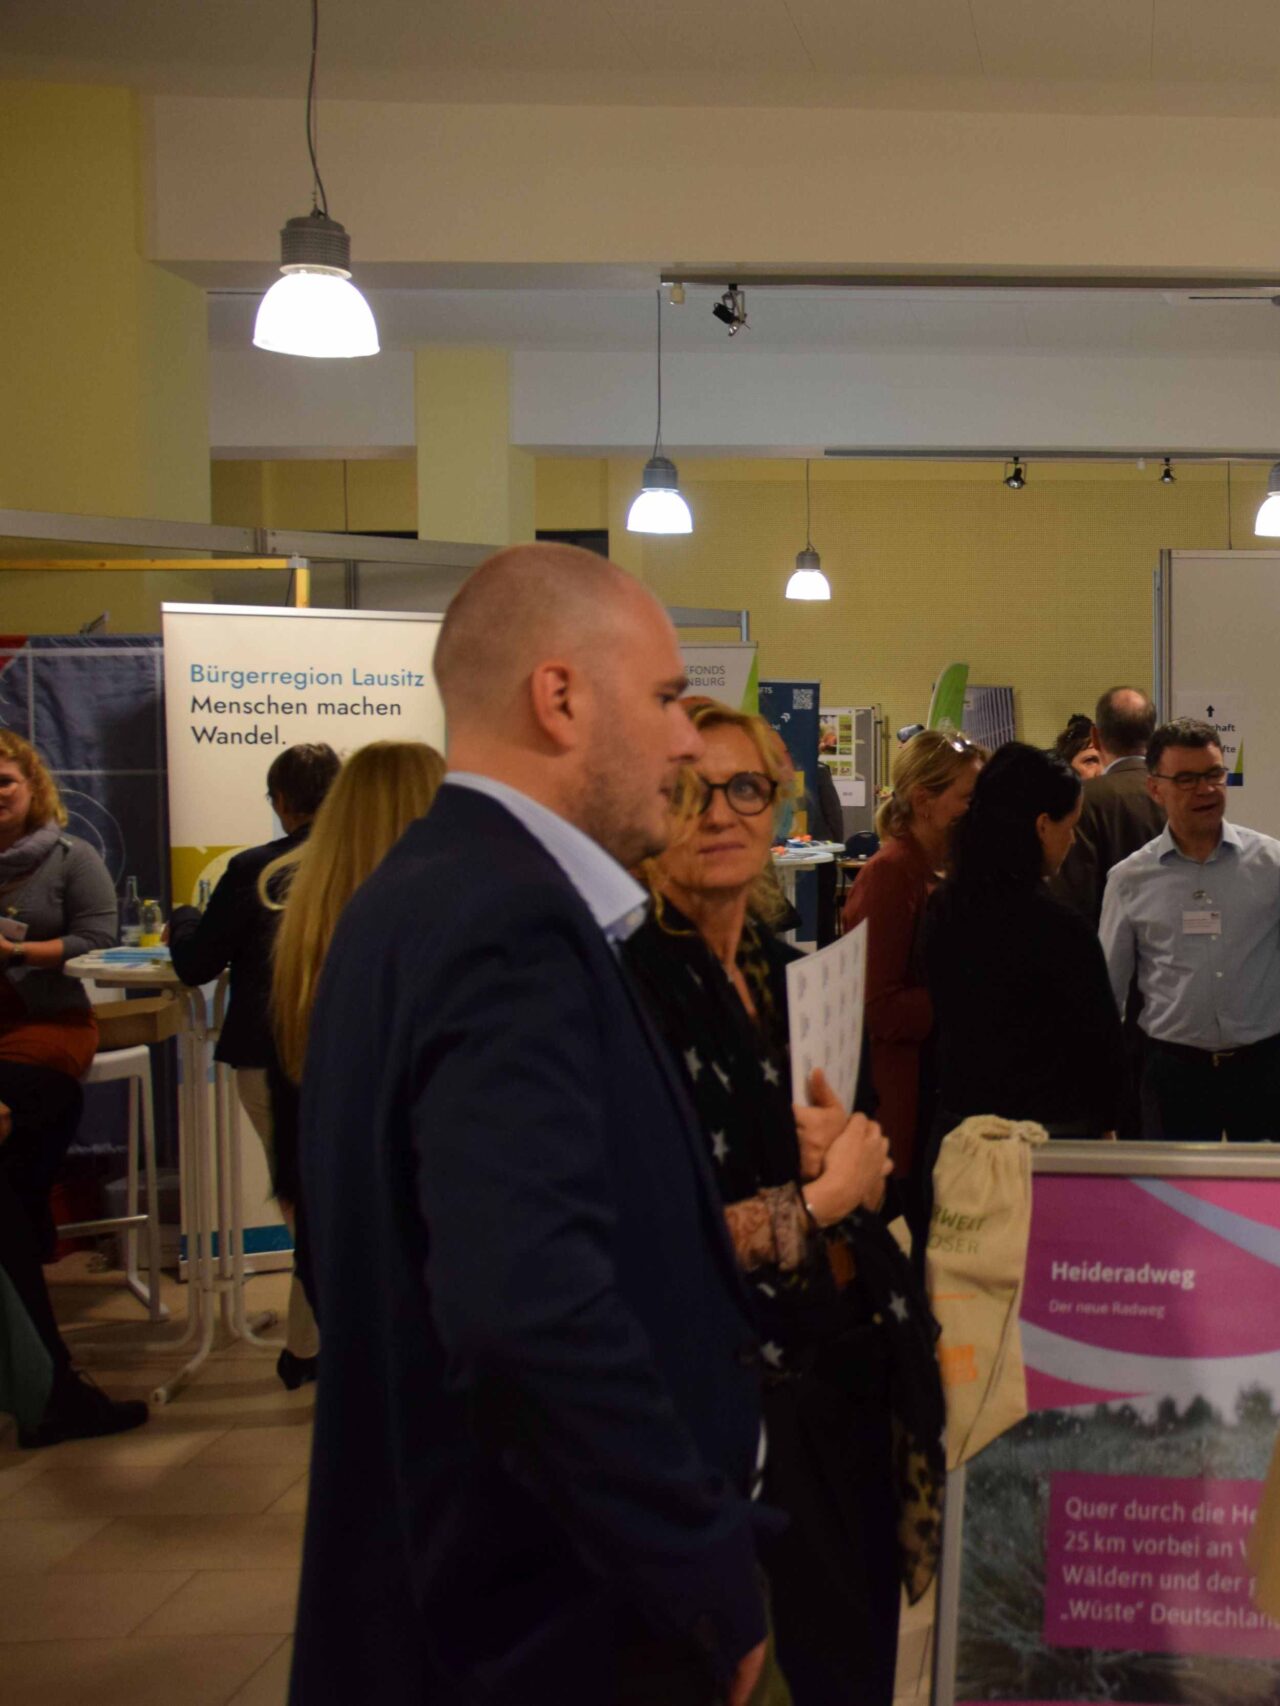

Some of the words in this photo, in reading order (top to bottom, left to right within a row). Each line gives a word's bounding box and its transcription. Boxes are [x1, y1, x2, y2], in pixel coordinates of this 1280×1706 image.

[190, 664, 343, 690] Bürgerregion
[352, 668, 425, 687] Lausitz
[190, 694, 308, 715] Menschen
[317, 696, 401, 716] machen
[190, 725, 287, 745] Wandel.
[1051, 1261, 1195, 1289] Heideradweg
[1049, 1300, 1073, 1314] Der
[1076, 1303, 1107, 1315] neue
[1111, 1301, 1166, 1319] Radweg
[1065, 1496, 1118, 1520] Quer
[1124, 1499, 1185, 1524] durch
[1192, 1503, 1225, 1524] die
[1064, 1531, 1088, 1551] 25
[1094, 1530, 1126, 1553] km
[1132, 1535, 1200, 1558] vorbei
[1206, 1541, 1233, 1558] an
[1062, 1564, 1153, 1587] Wäldern
[1160, 1571, 1200, 1591] und
[1206, 1572, 1243, 1593] der
